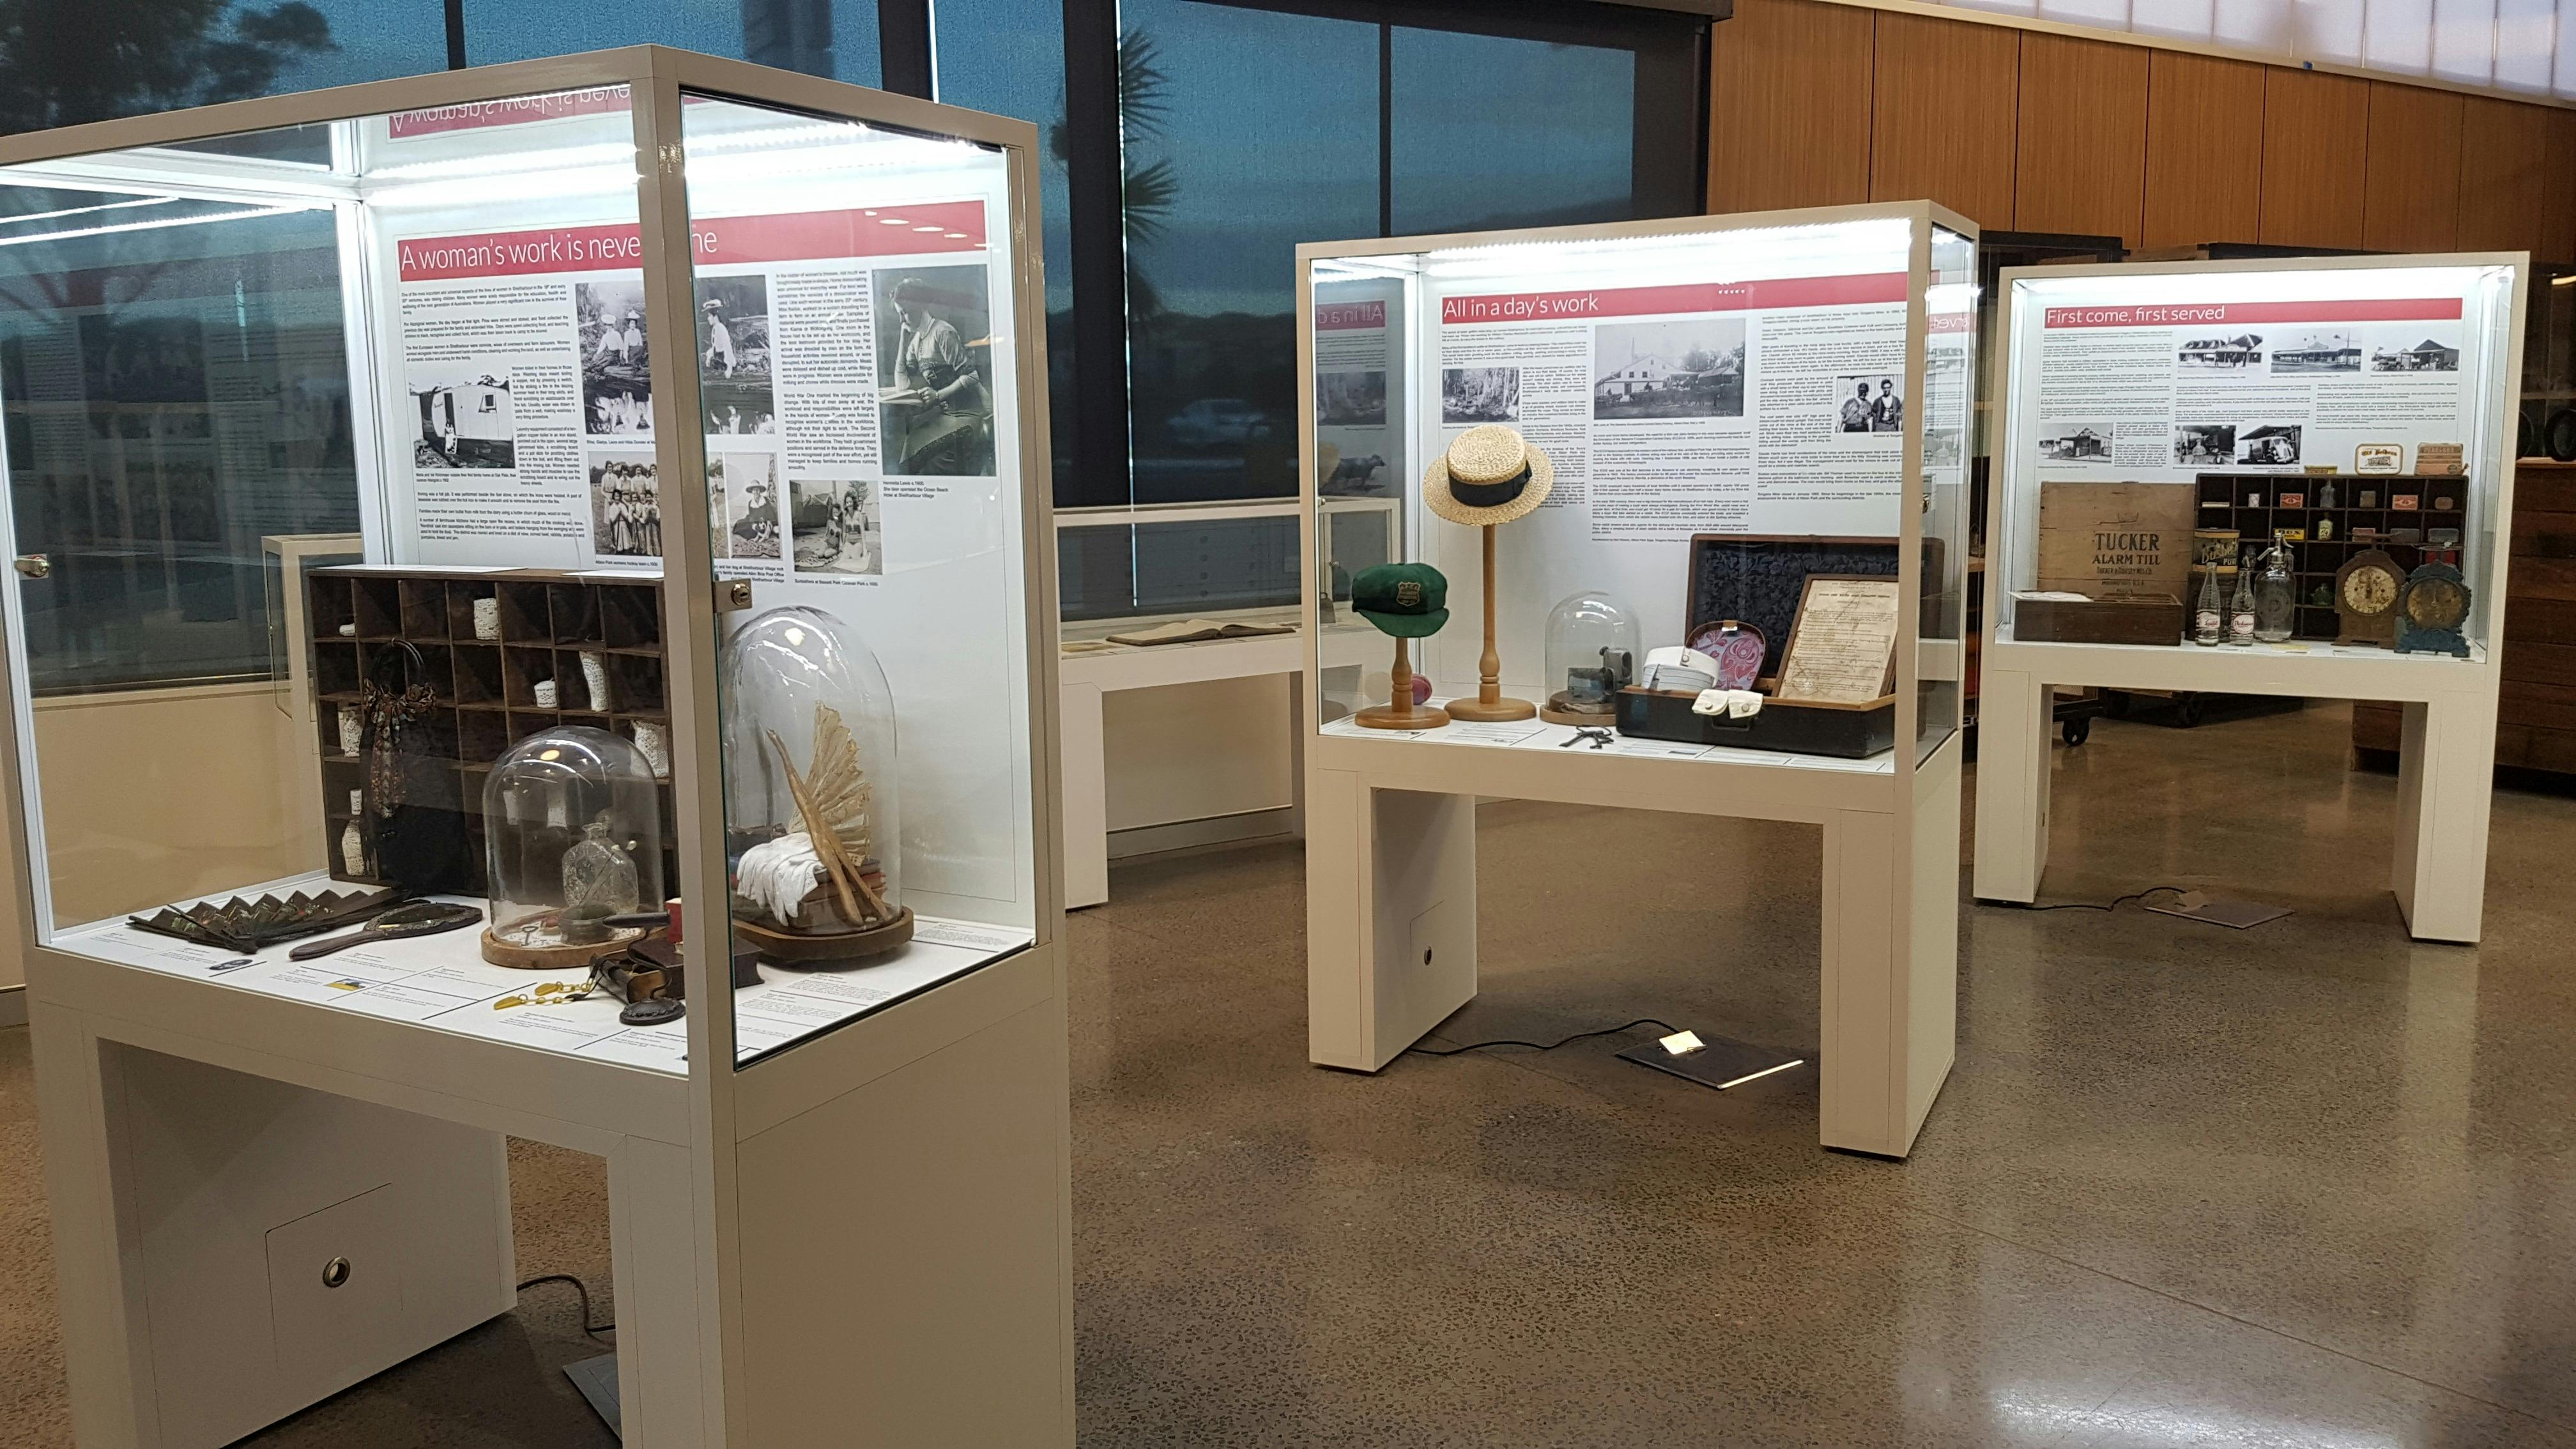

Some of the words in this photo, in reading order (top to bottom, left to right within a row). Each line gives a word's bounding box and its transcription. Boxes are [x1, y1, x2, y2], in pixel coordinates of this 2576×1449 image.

[401, 245, 416, 272] A
[422, 239, 504, 270] woman's
[509, 239, 562, 264] work
[567, 234, 583, 260] is
[590, 235, 641, 259] neve
[1444, 300, 1466, 318] All
[1471, 299, 1486, 317] in
[1491, 302, 1499, 316] a
[1504, 296, 1548, 318] day's
[1552, 293, 1598, 312] work
[2047, 309, 2082, 324] First
[2086, 311, 2132, 323] come,
[2136, 307, 2167, 321] first
[2172, 305, 2225, 320] served
[2095, 533, 2160, 551] TUCKER
[2092, 554, 2133, 564] ALARM
[2136, 554, 2161, 565] TILL
